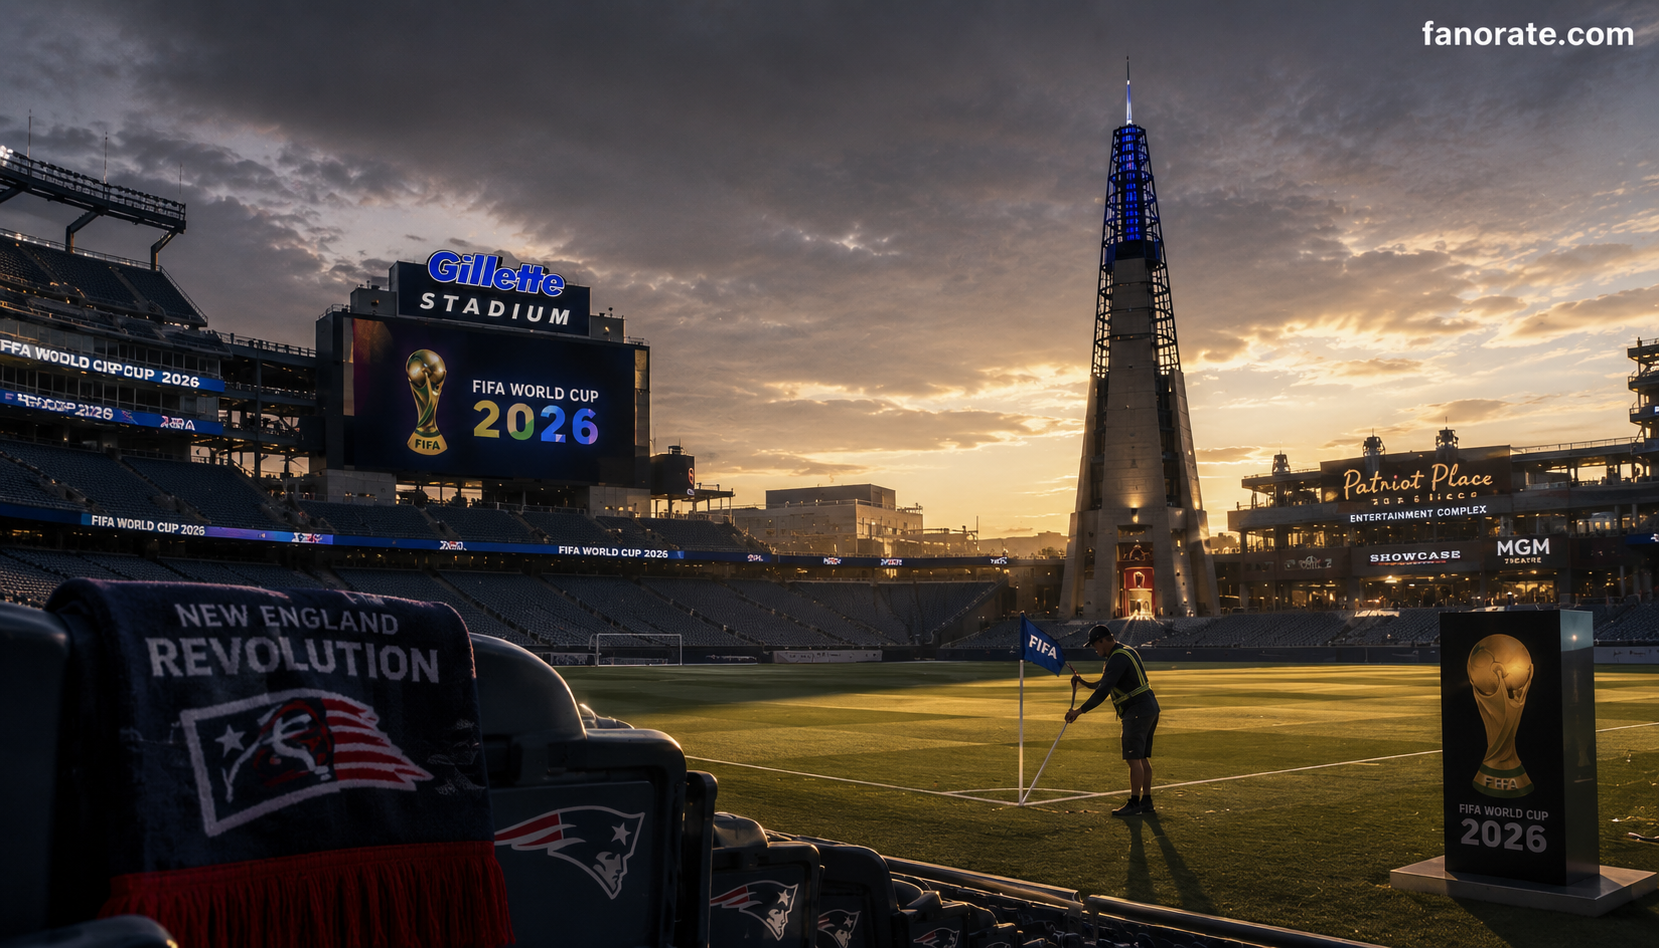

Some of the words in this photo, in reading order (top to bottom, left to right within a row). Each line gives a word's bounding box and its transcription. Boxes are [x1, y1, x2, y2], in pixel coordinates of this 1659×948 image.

[427, 250, 567, 297] Gillette
[419, 292, 571, 326] STADIUM
[124, 365, 155, 381] CUP
[162, 371, 200, 388] 2026
[472, 379, 506, 396] FIFA
[509, 382, 565, 401] WORLD
[569, 388, 600, 403] CUP
[473, 399, 599, 446] 2026
[414, 438, 441, 451] FIFA
[1343, 469, 1424, 500] Patriot
[1431, 463, 1493, 492] Place
[91, 515, 115, 528] FIFA
[117, 517, 155, 531] WORLD
[157, 522, 179, 534] CUP
[181, 524, 206, 536] 2026
[1350, 509, 1434, 523] ENTERTAINMENT
[1437, 505, 1487, 517] COMPLEX
[558, 546, 580, 555] FIFA
[582, 547, 619, 557] WORLD
[621, 549, 642, 557] CUP
[644, 550, 669, 559] 2026
[1370, 550, 1461, 562] SHOWCASE
[1497, 538, 1550, 556] MGM
[175, 604, 249, 628] NEW
[259, 605, 399, 635] ENGLAND
[1029, 634, 1057, 659] FIFA
[145, 636, 440, 684] REVOLUTION
[1459, 804, 1482, 815] FIFA
[1484, 806, 1523, 819] WORLD
[1526, 810, 1549, 821] CUP
[1460, 818, 1547, 853] 2026
